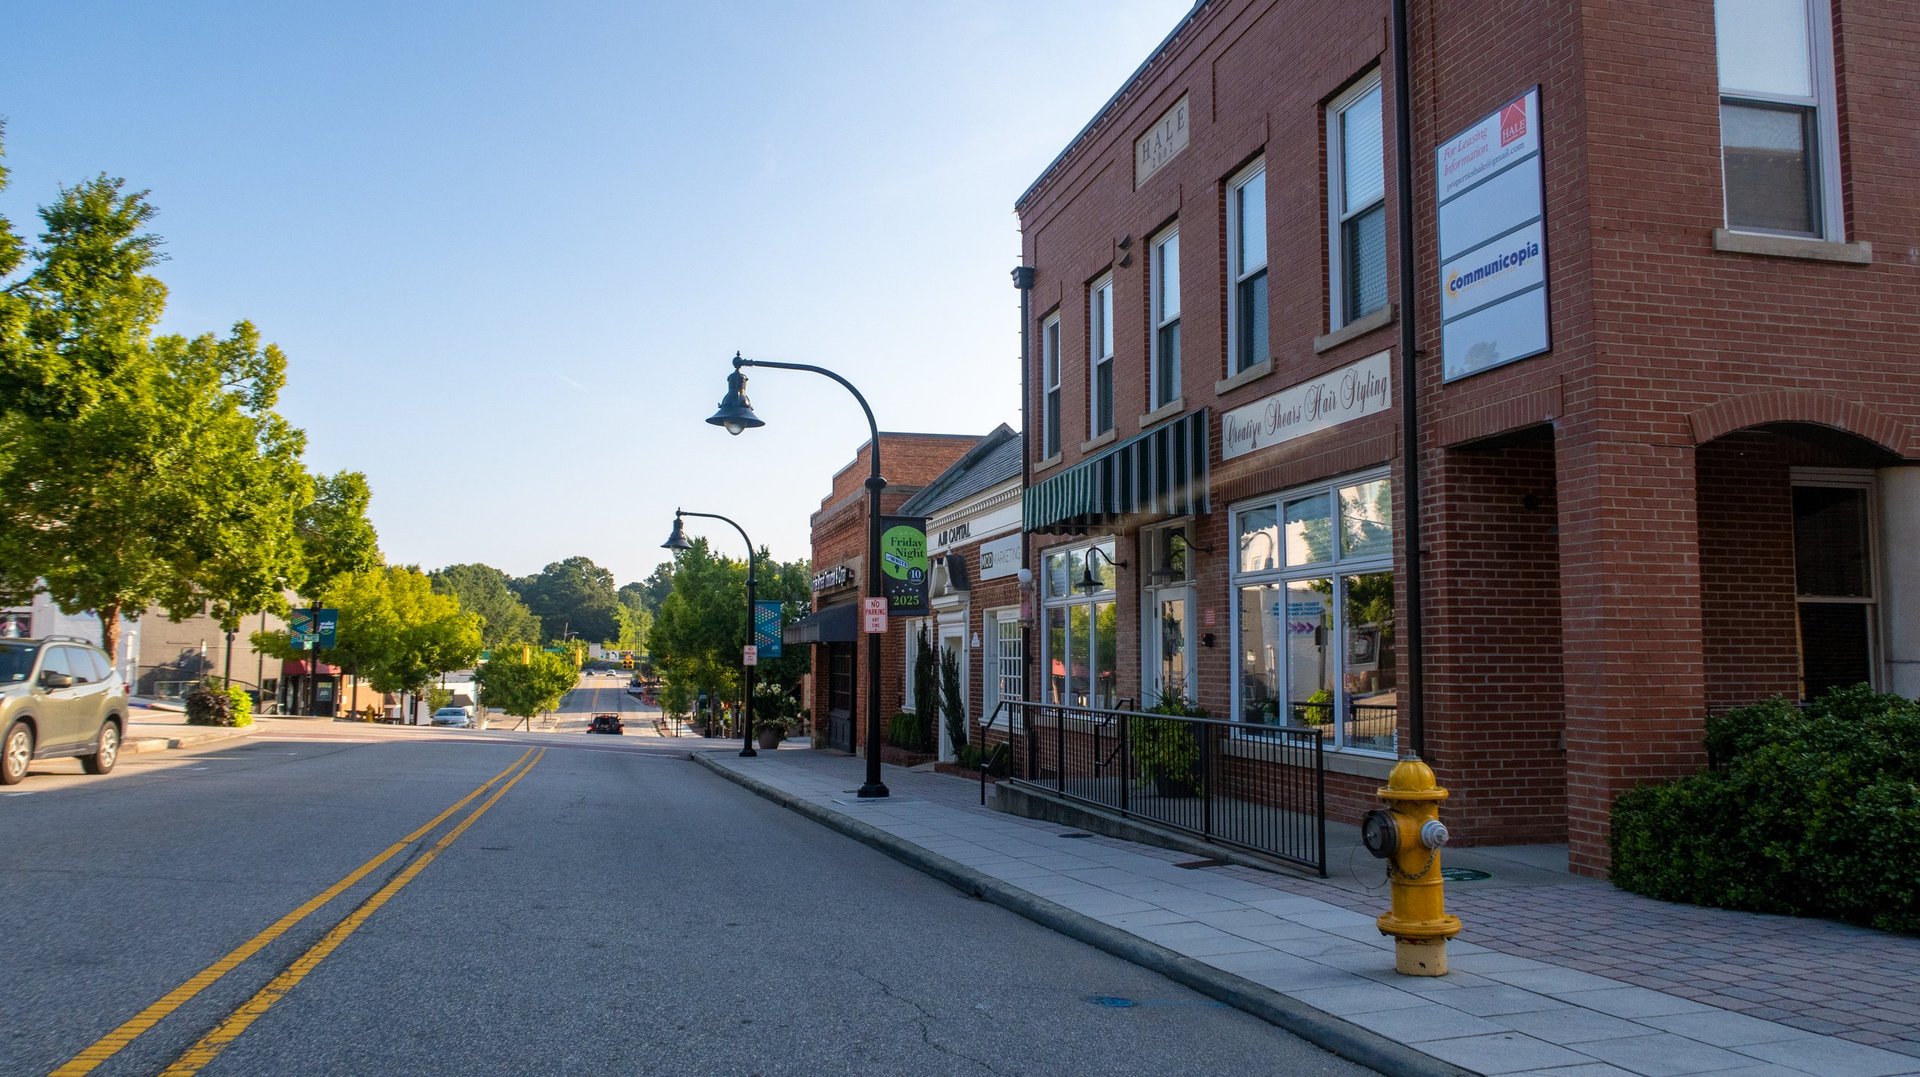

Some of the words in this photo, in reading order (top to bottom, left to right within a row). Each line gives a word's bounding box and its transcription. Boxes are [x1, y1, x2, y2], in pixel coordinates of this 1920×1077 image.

[1142, 106, 1185, 164] HALE
[1502, 119, 1526, 140] HALE
[1444, 146, 1456, 161] For
[1457, 127, 1488, 152] Leasing
[1444, 143, 1489, 177] Information
[1450, 241, 1539, 292] communicopia
[1224, 414, 1262, 450] Creative
[1264, 397, 1302, 436] Shears
[1304, 383, 1338, 422] Hair
[1340, 368, 1388, 413] Styling
[890, 536, 924, 549] Friday
[948, 522, 971, 543] CAPITAL
[895, 548, 924, 560] Night
[910, 569, 921, 579] 10
[870, 600, 880, 608] NO
[893, 595, 920, 606] 2025
[865, 608, 887, 616] PARKING
